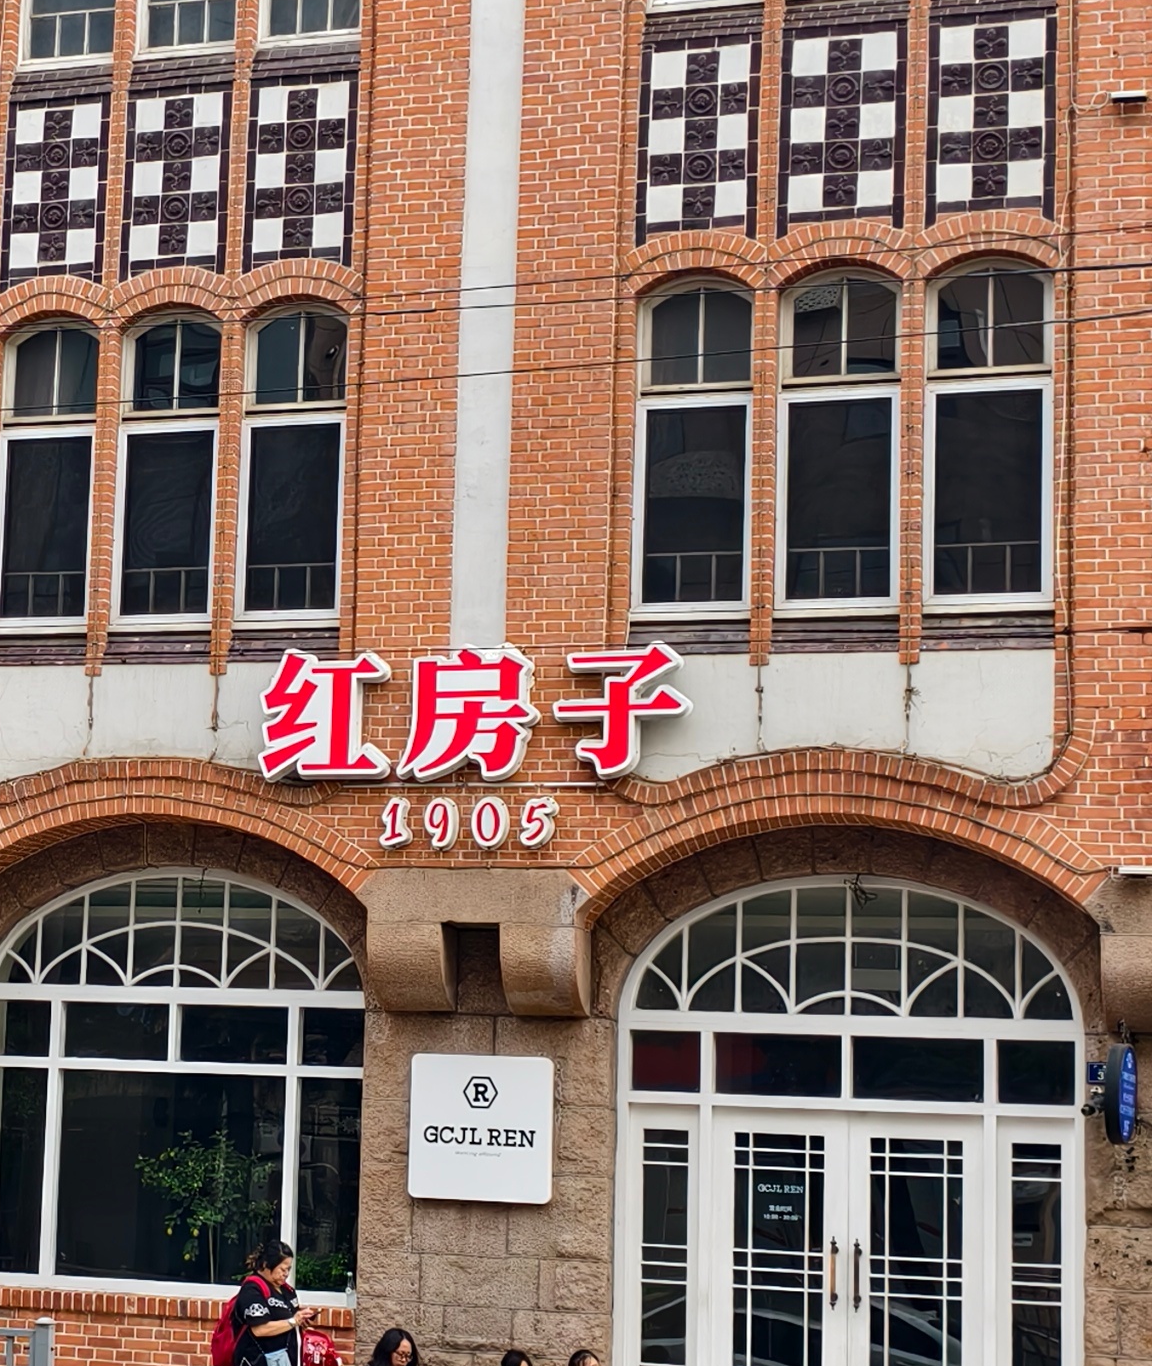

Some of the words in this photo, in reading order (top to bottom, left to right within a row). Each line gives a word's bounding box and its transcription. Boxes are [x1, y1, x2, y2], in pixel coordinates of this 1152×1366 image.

[259, 642, 693, 781] 红房子
[380, 797, 559, 849] 1905
[473, 1083, 489, 1102] R
[423, 1125, 483, 1145] GCJL
[487, 1128, 536, 1148] REN
[784, 1184, 804, 1194] REN
